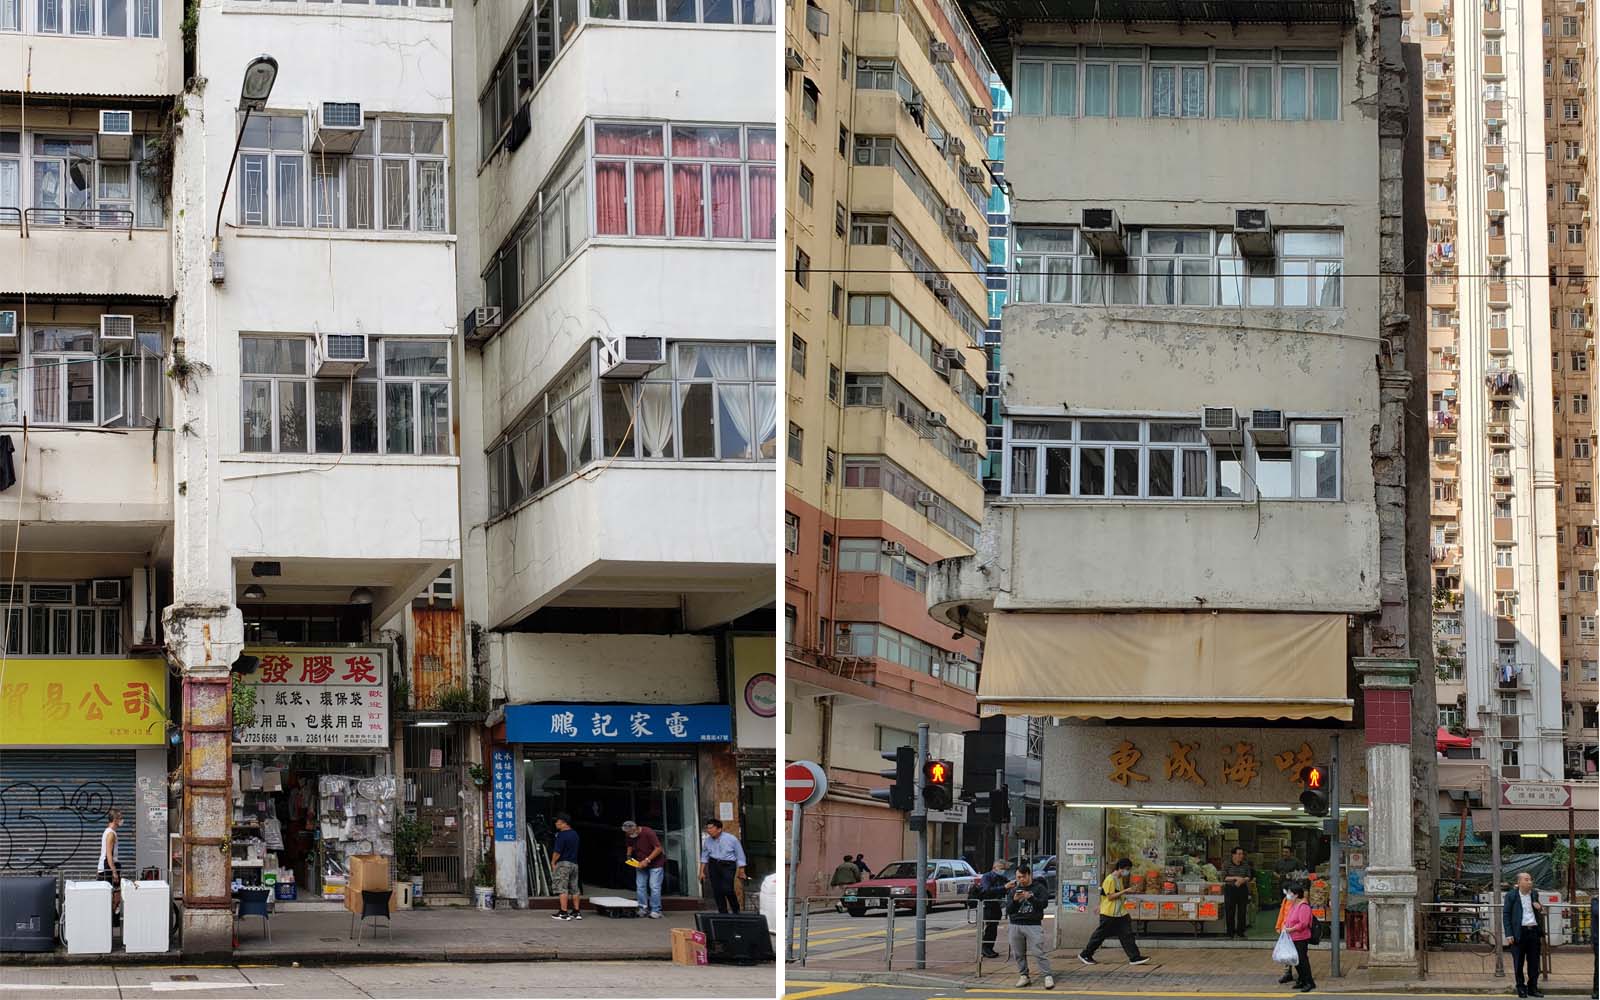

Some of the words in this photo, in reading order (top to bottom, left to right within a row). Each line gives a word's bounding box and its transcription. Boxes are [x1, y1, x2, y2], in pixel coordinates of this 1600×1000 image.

[238, 655, 377, 683] 發膠袋
[4, 682, 150, 720] 貿易公司
[253, 691, 363, 706] 、紙袋、環保袋
[551, 711, 689, 738] 鵬記家電
